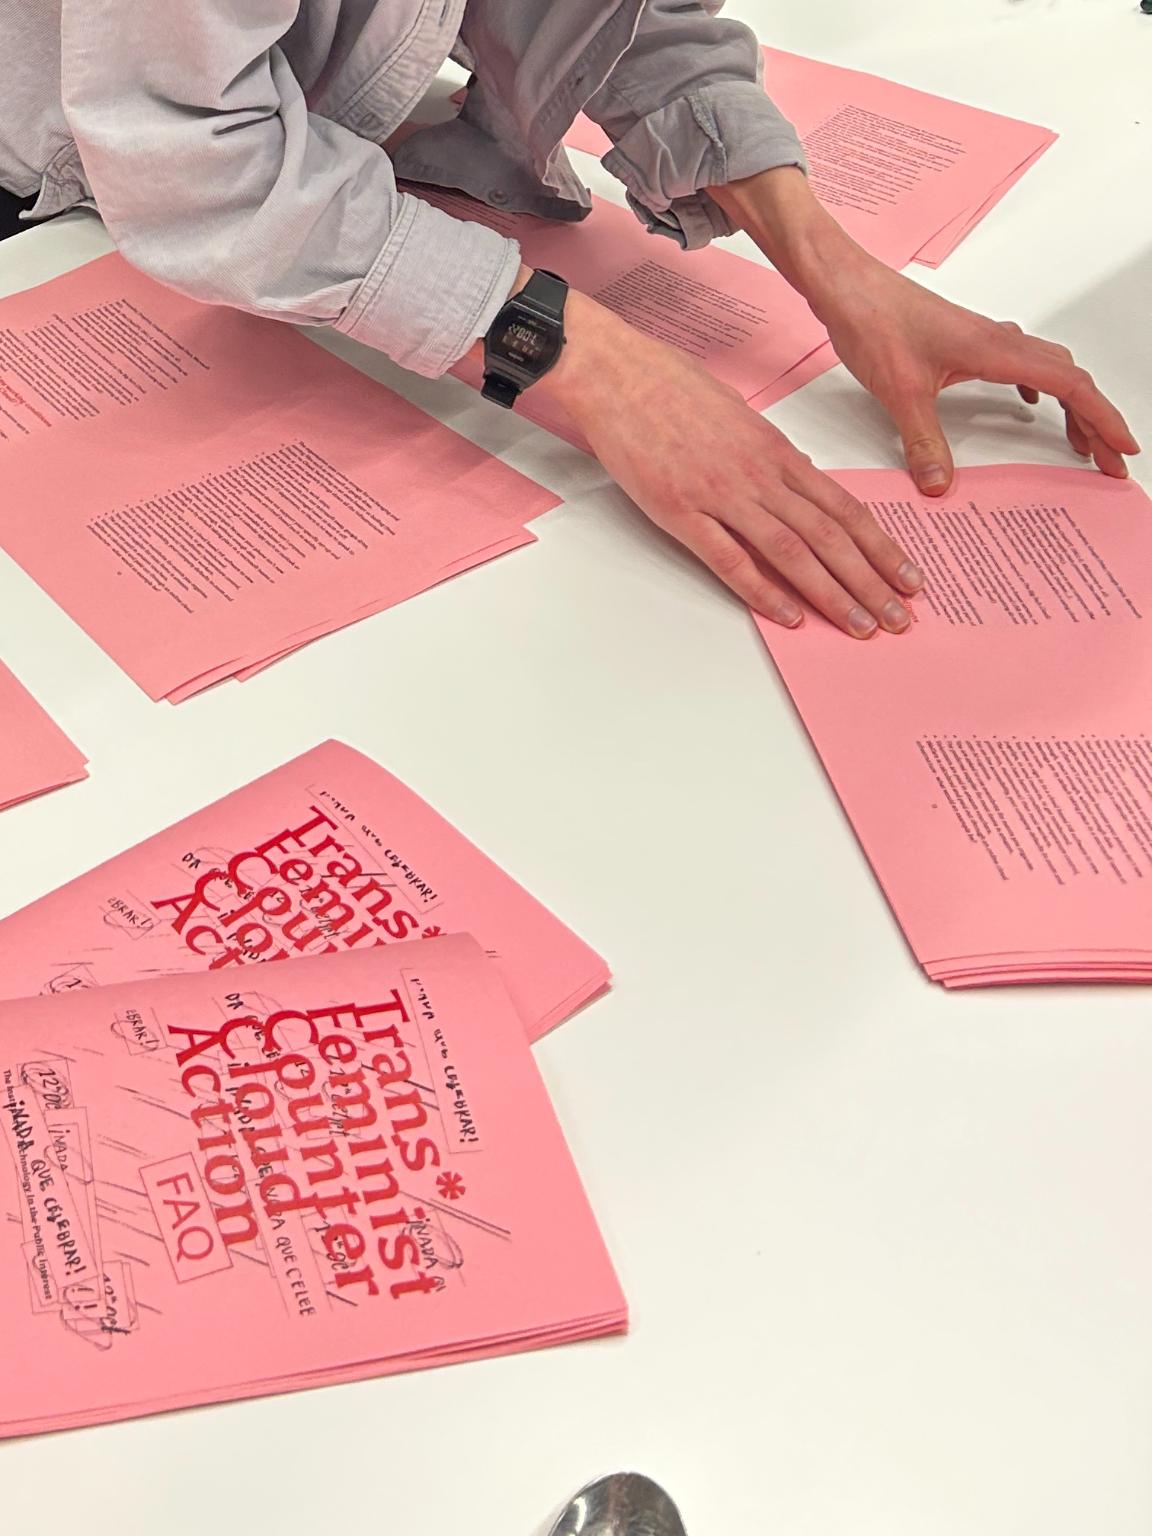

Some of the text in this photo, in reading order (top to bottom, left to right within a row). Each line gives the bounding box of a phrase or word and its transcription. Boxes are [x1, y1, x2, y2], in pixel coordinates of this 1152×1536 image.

[31, 1159, 54, 1192] QUE
[157, 1172, 214, 1262] FAQ
[168, 1024, 259, 1246] Action
[218, 1016, 316, 1217] Cloud
[264, 1010, 379, 1296] Counter
[307, 1003, 439, 1298] Feminist
